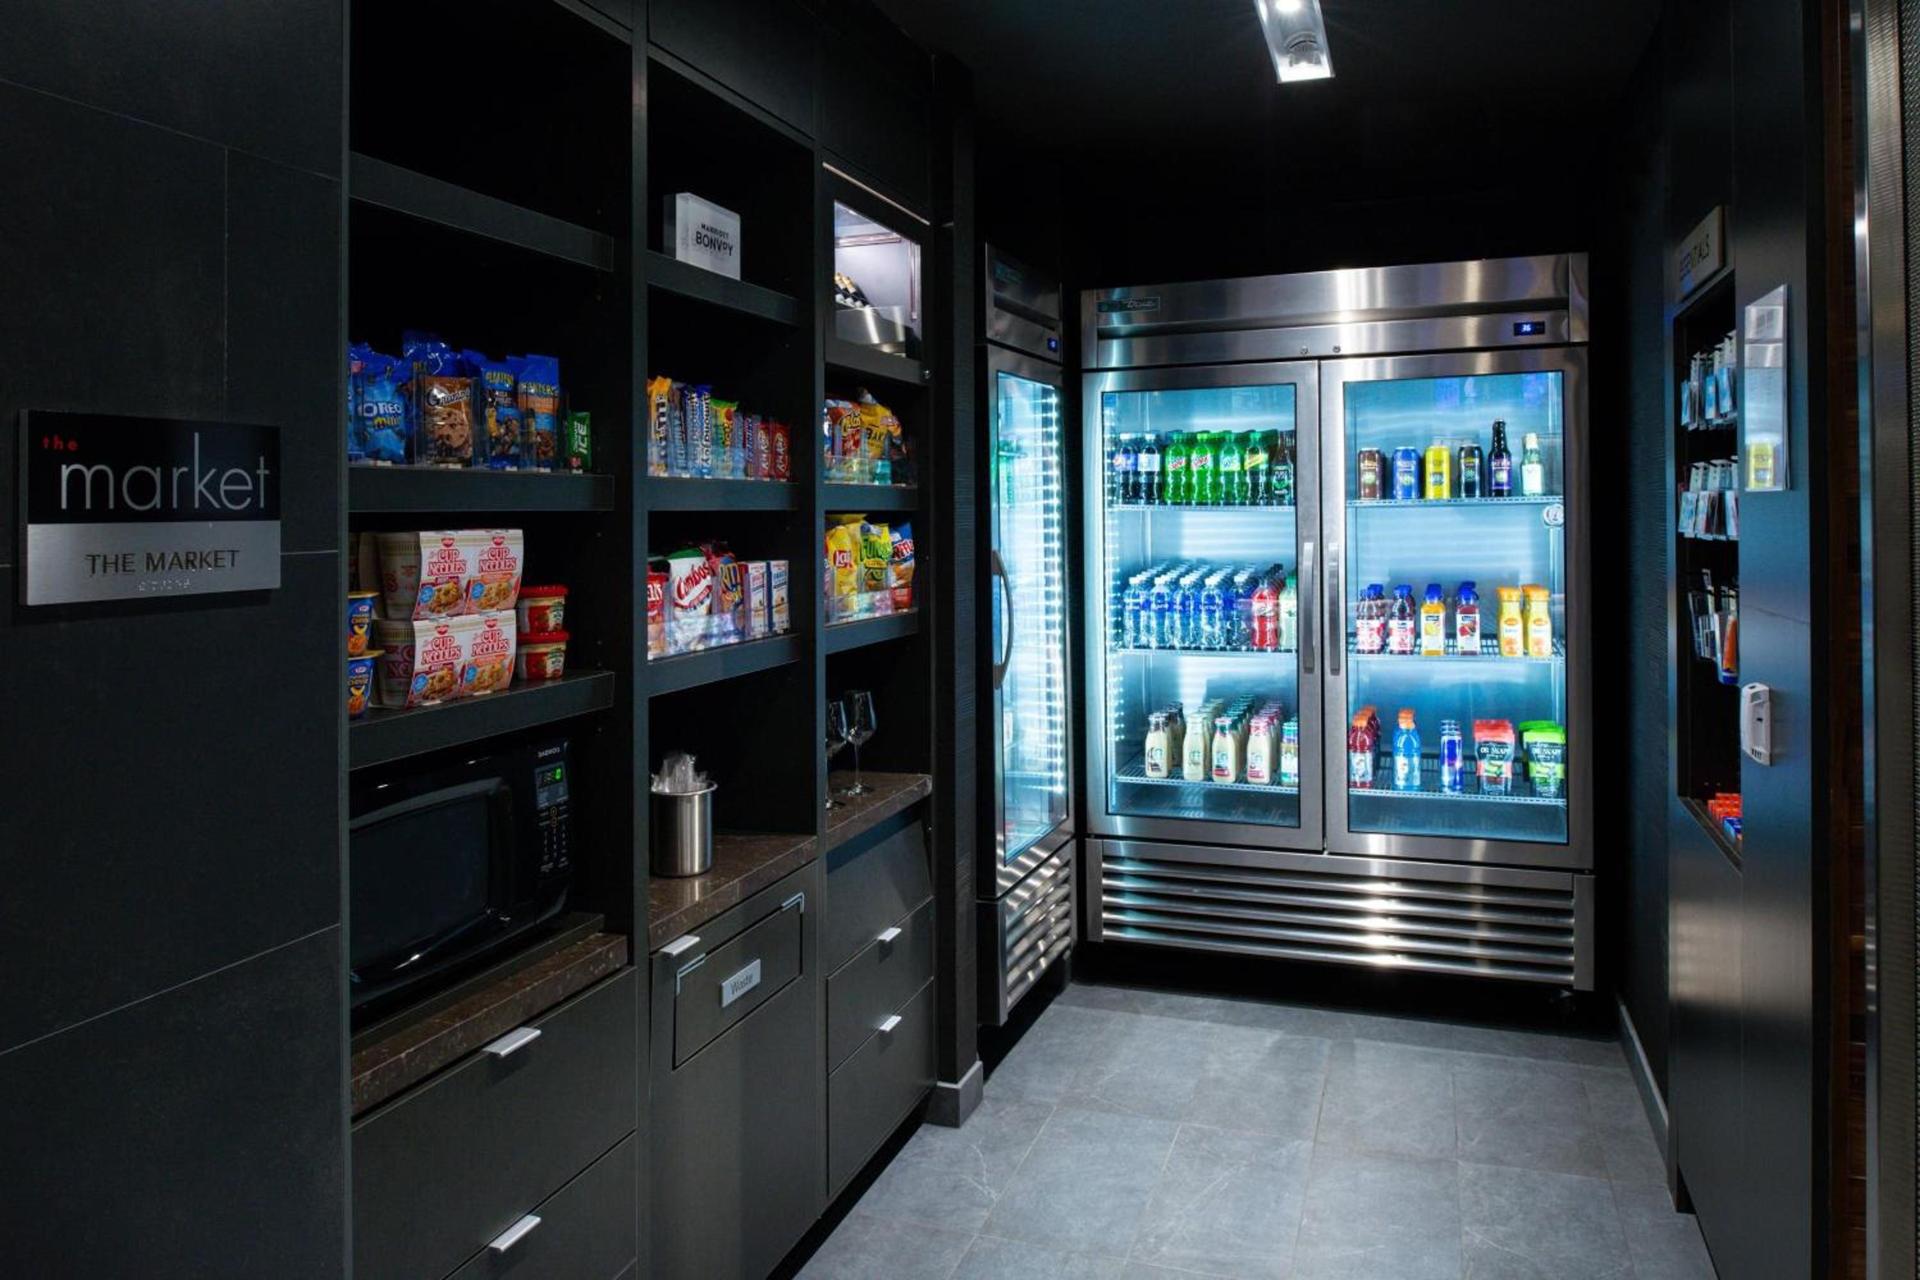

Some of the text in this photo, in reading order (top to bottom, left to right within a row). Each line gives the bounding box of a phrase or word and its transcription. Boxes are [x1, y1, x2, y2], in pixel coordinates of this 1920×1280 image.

[695, 230, 733, 257] BONVOY
[358, 402, 402, 417] OREO
[41, 434, 79, 452] the
[60, 432, 271, 511] market
[438, 549, 460, 560] CUP
[488, 547, 511, 559] CUP
[86, 548, 241, 576] THE MARKET
[676, 561, 711, 600] Combos
[431, 636, 455, 650] CUP
[481, 629, 503, 643] CUP
